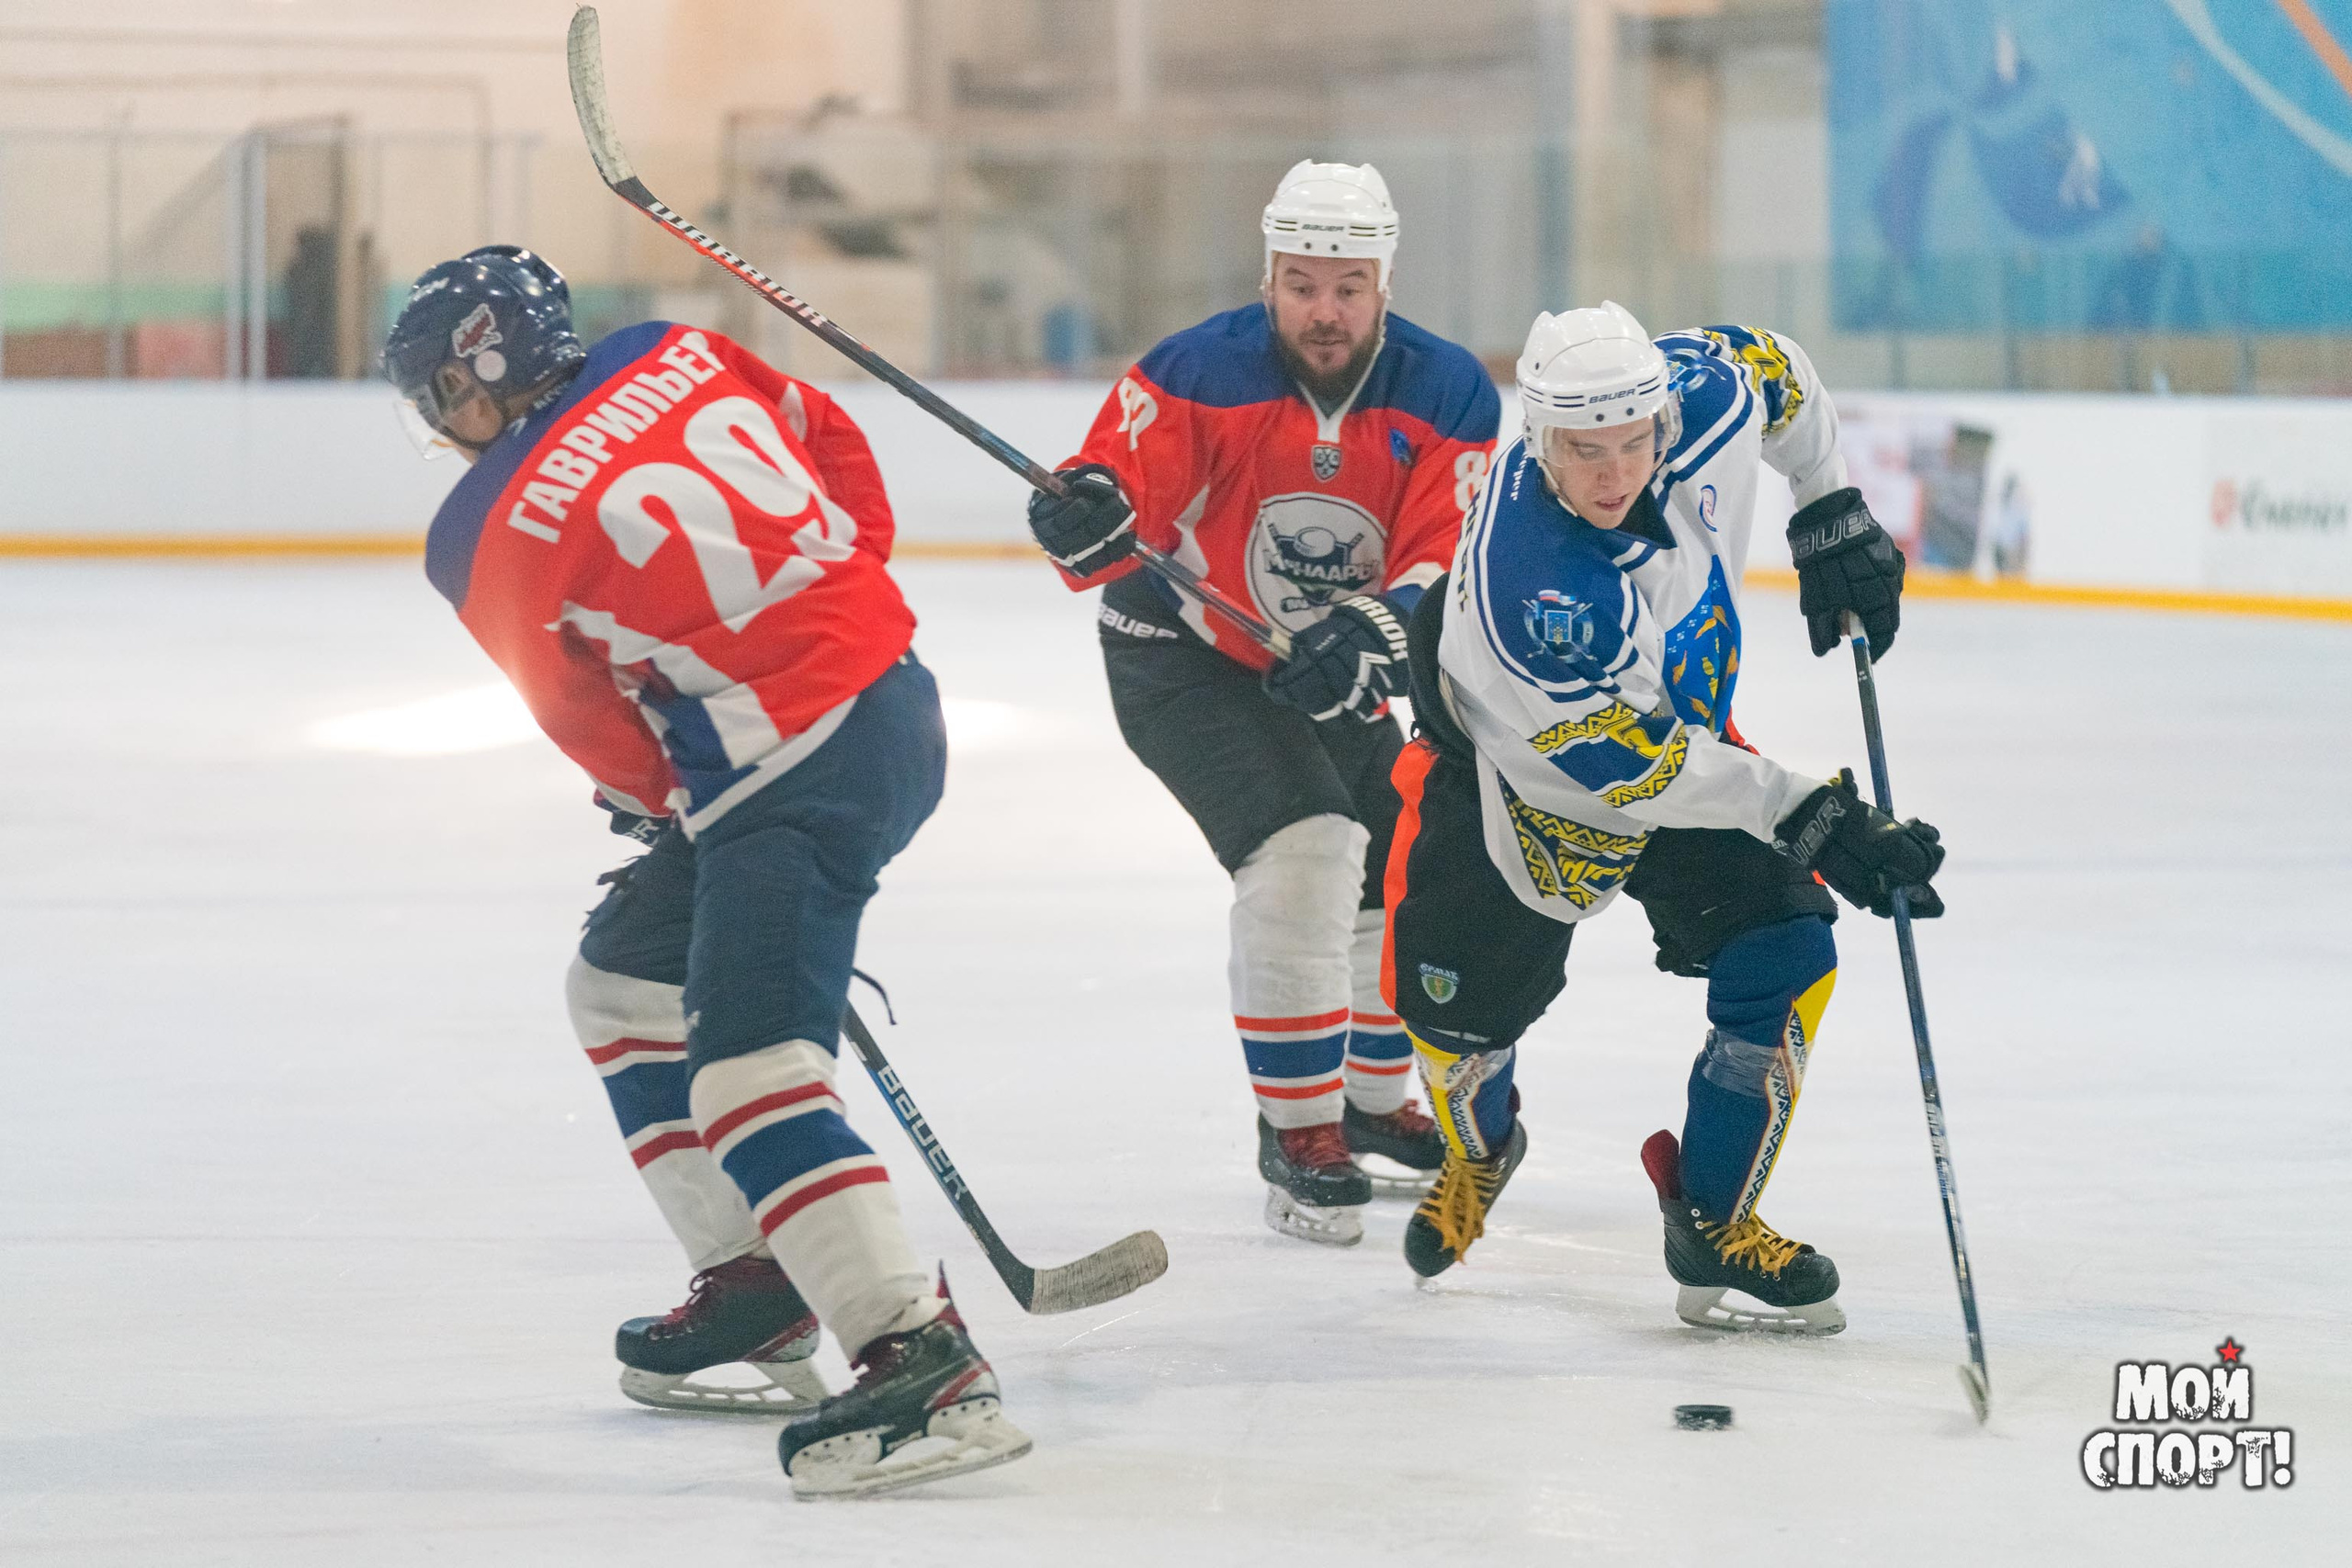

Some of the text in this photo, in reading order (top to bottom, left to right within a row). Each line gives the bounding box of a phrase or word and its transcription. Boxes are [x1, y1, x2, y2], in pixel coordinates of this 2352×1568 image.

[1589, 389, 1636, 403] BAUER
[597, 396, 858, 635] 29
[877, 1064, 969, 1201] BAUER
